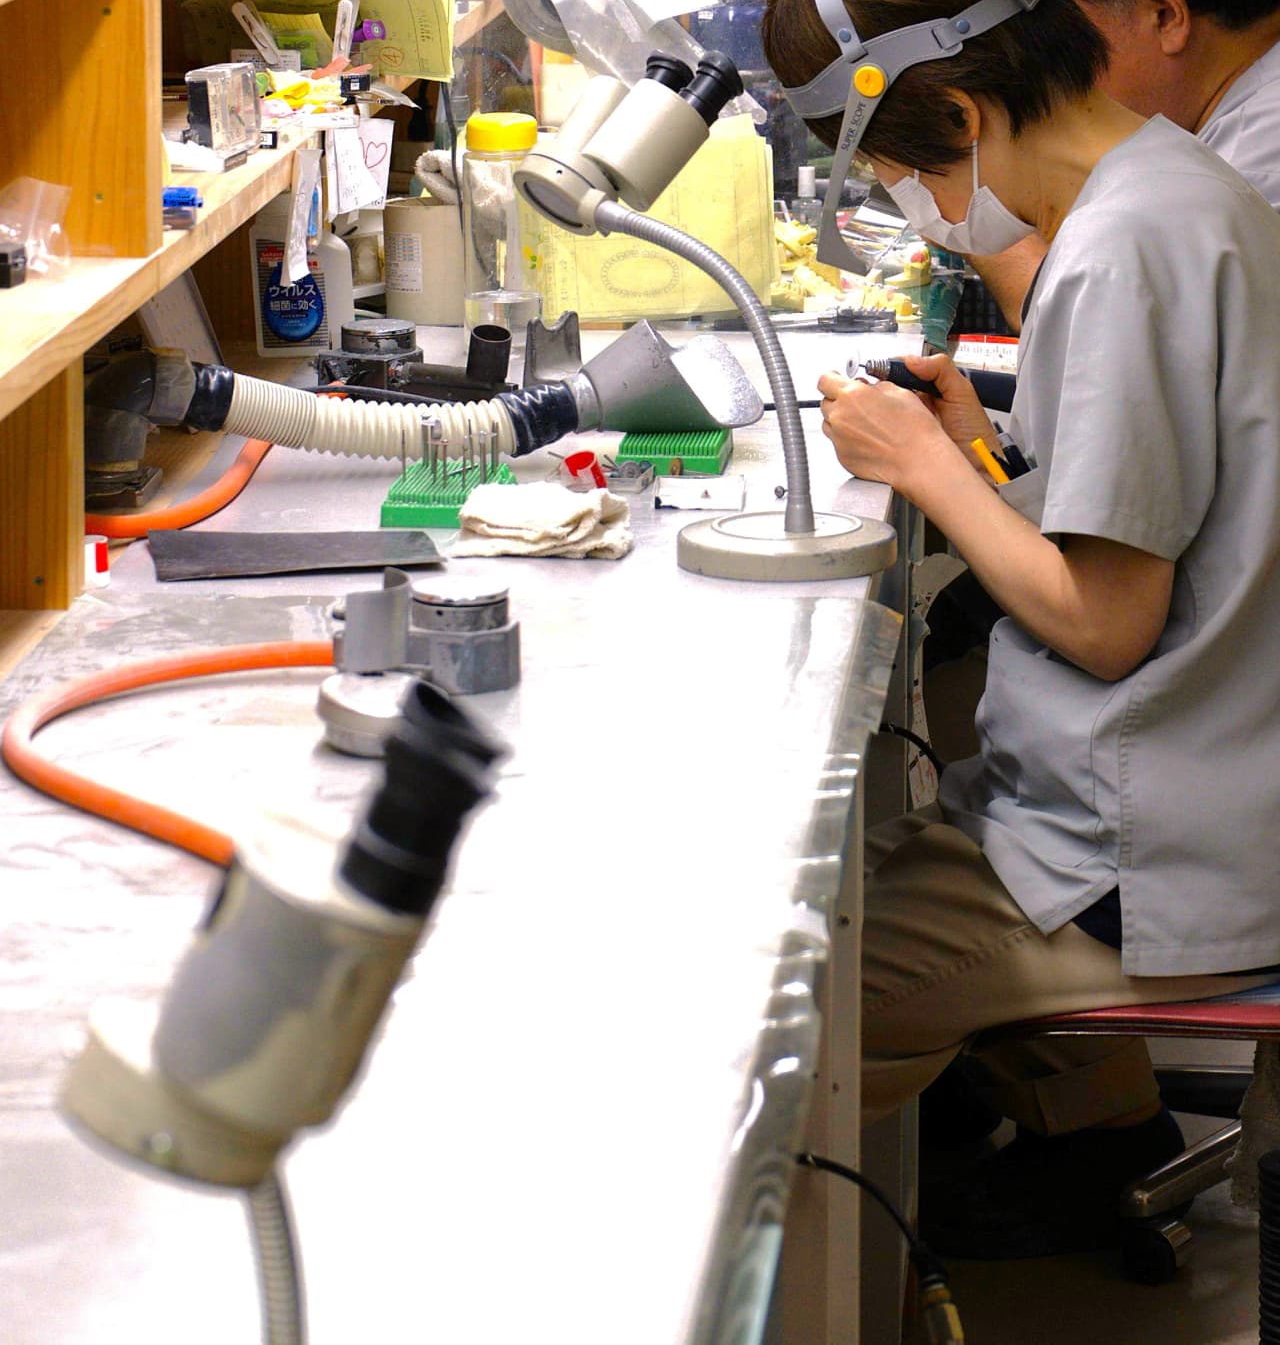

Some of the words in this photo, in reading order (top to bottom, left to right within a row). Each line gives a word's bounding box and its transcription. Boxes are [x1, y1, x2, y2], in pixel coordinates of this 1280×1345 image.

[841, 128, 856, 151] SUPER
[851, 101, 867, 126] SCOPE
[270, 299, 317, 311] 細菌に効く
